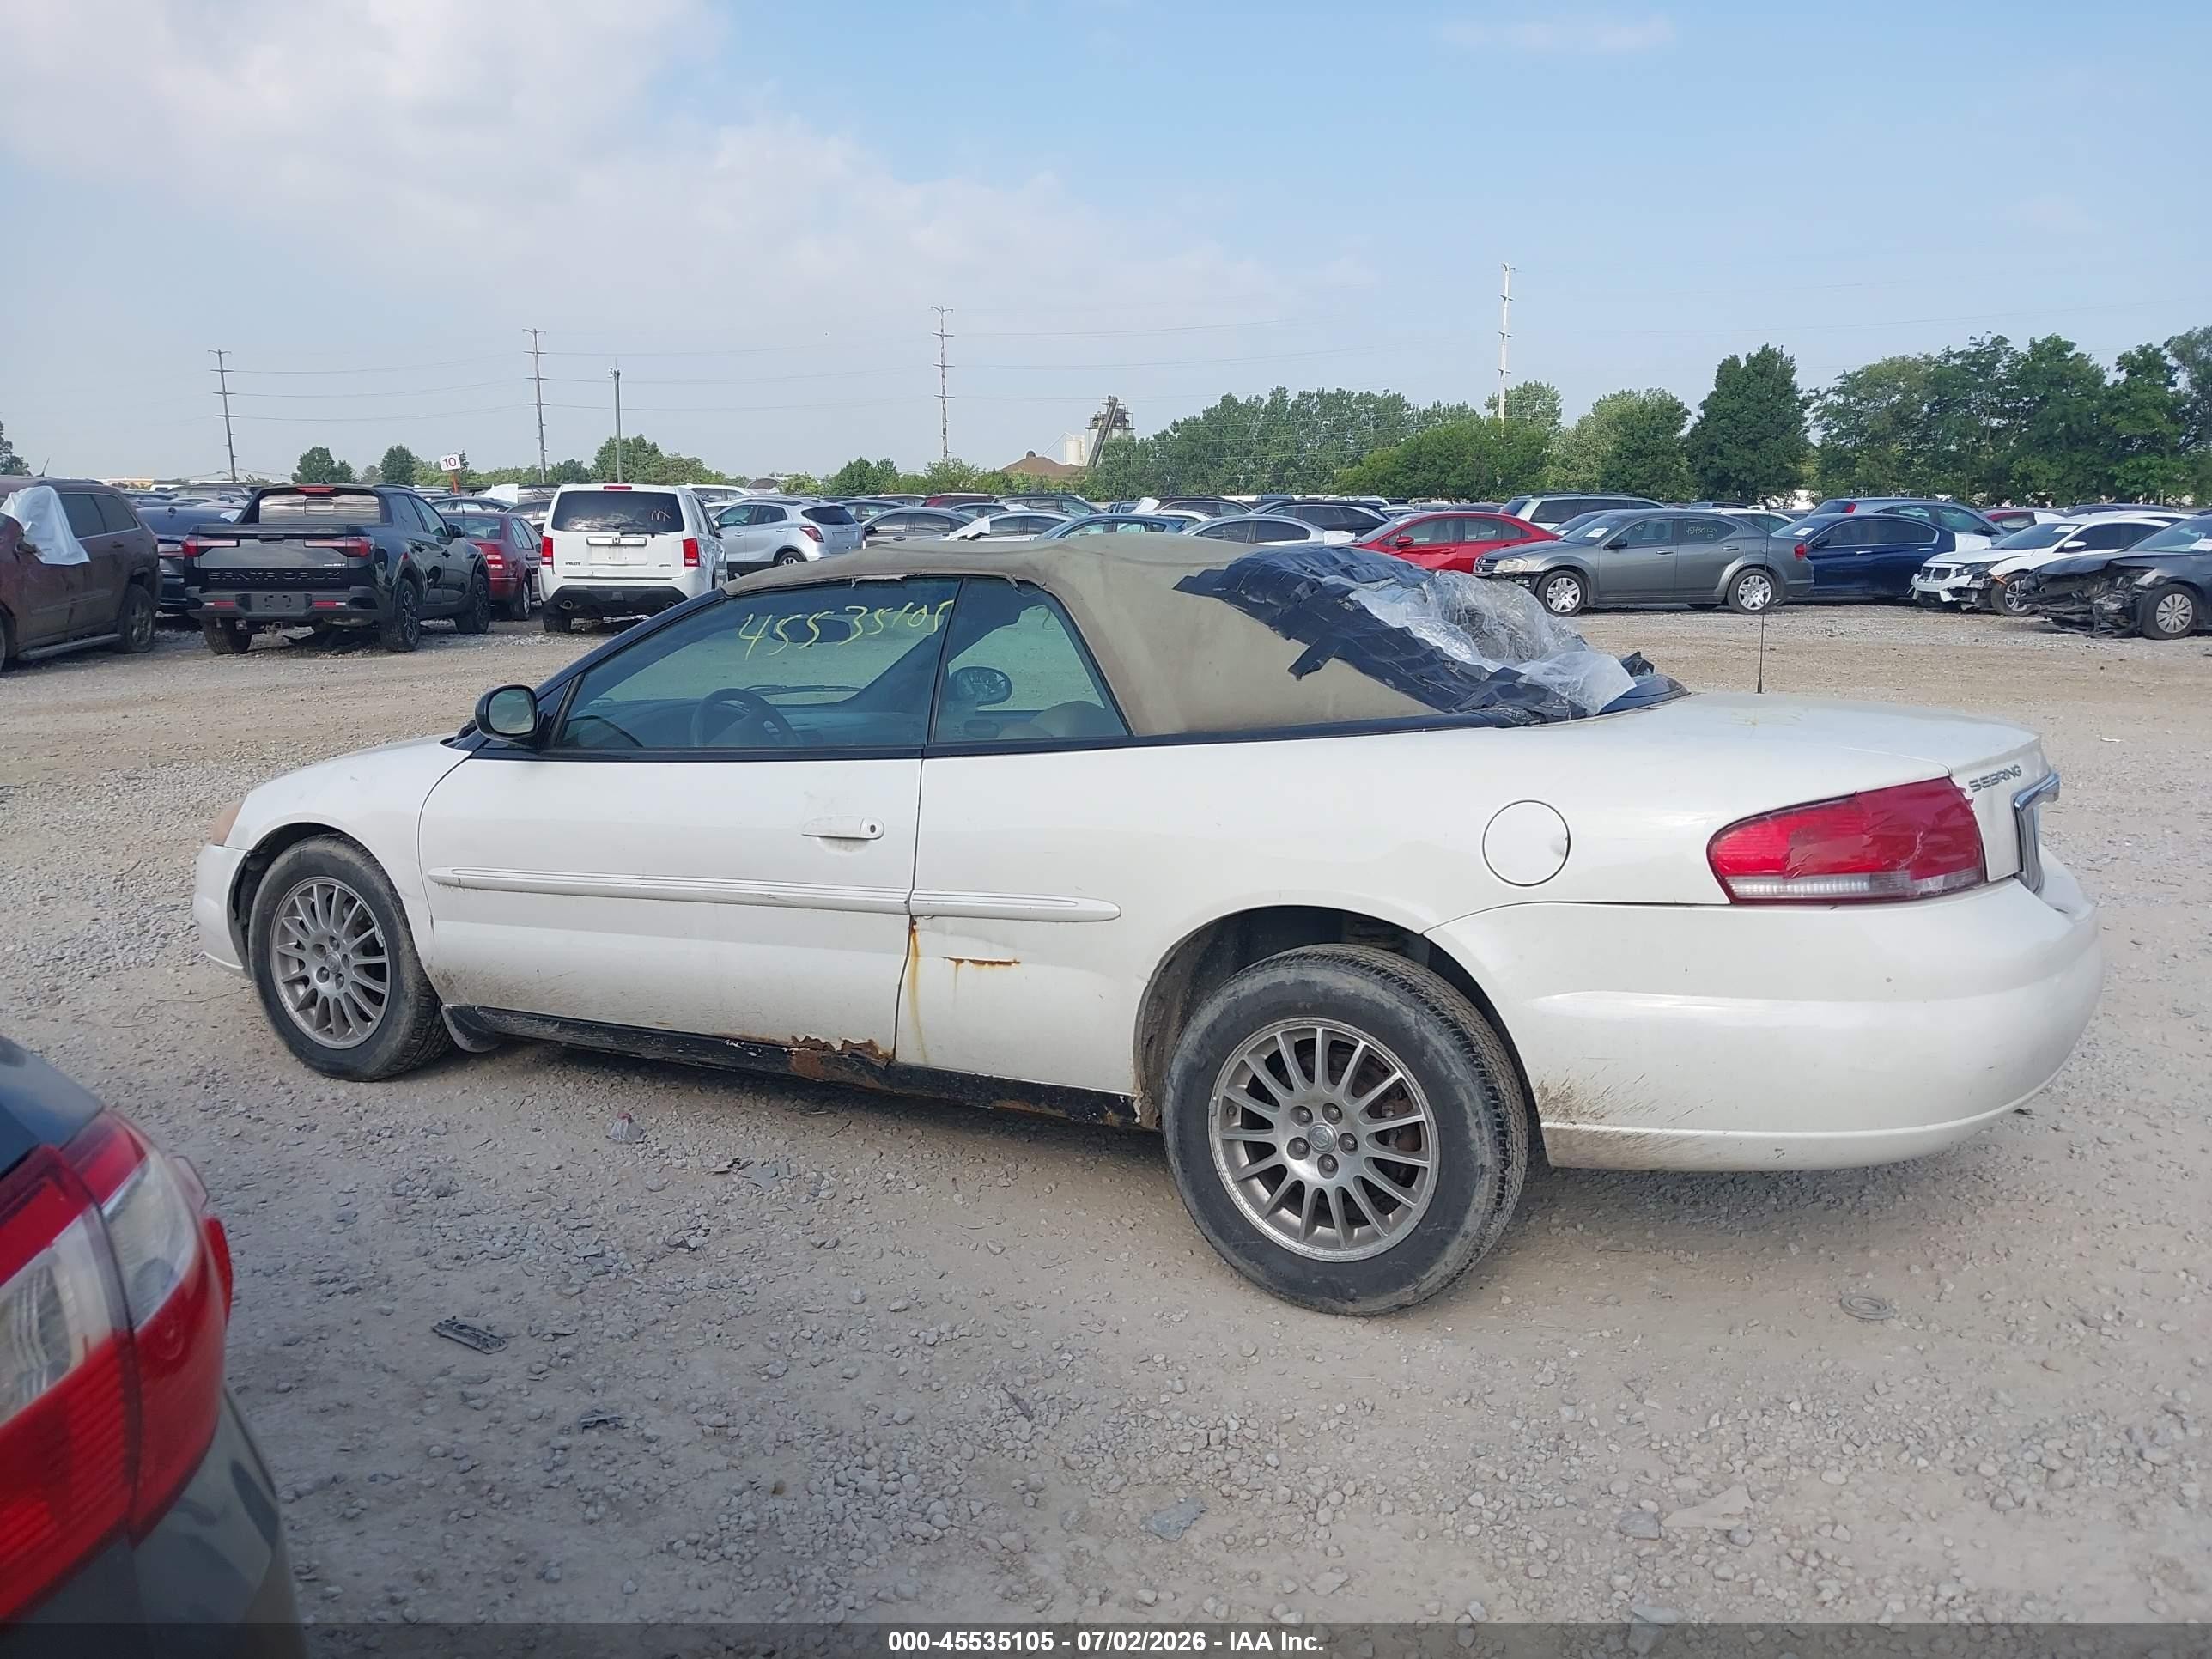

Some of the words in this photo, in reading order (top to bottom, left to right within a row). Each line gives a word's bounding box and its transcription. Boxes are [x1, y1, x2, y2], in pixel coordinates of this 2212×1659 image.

[442, 457, 457, 467] 10
[208, 571, 278, 580] SANTA
[283, 571, 342, 580] CRUZ
[738, 599, 955, 661] 45535105
[1968, 763, 2022, 793] SEBRING
